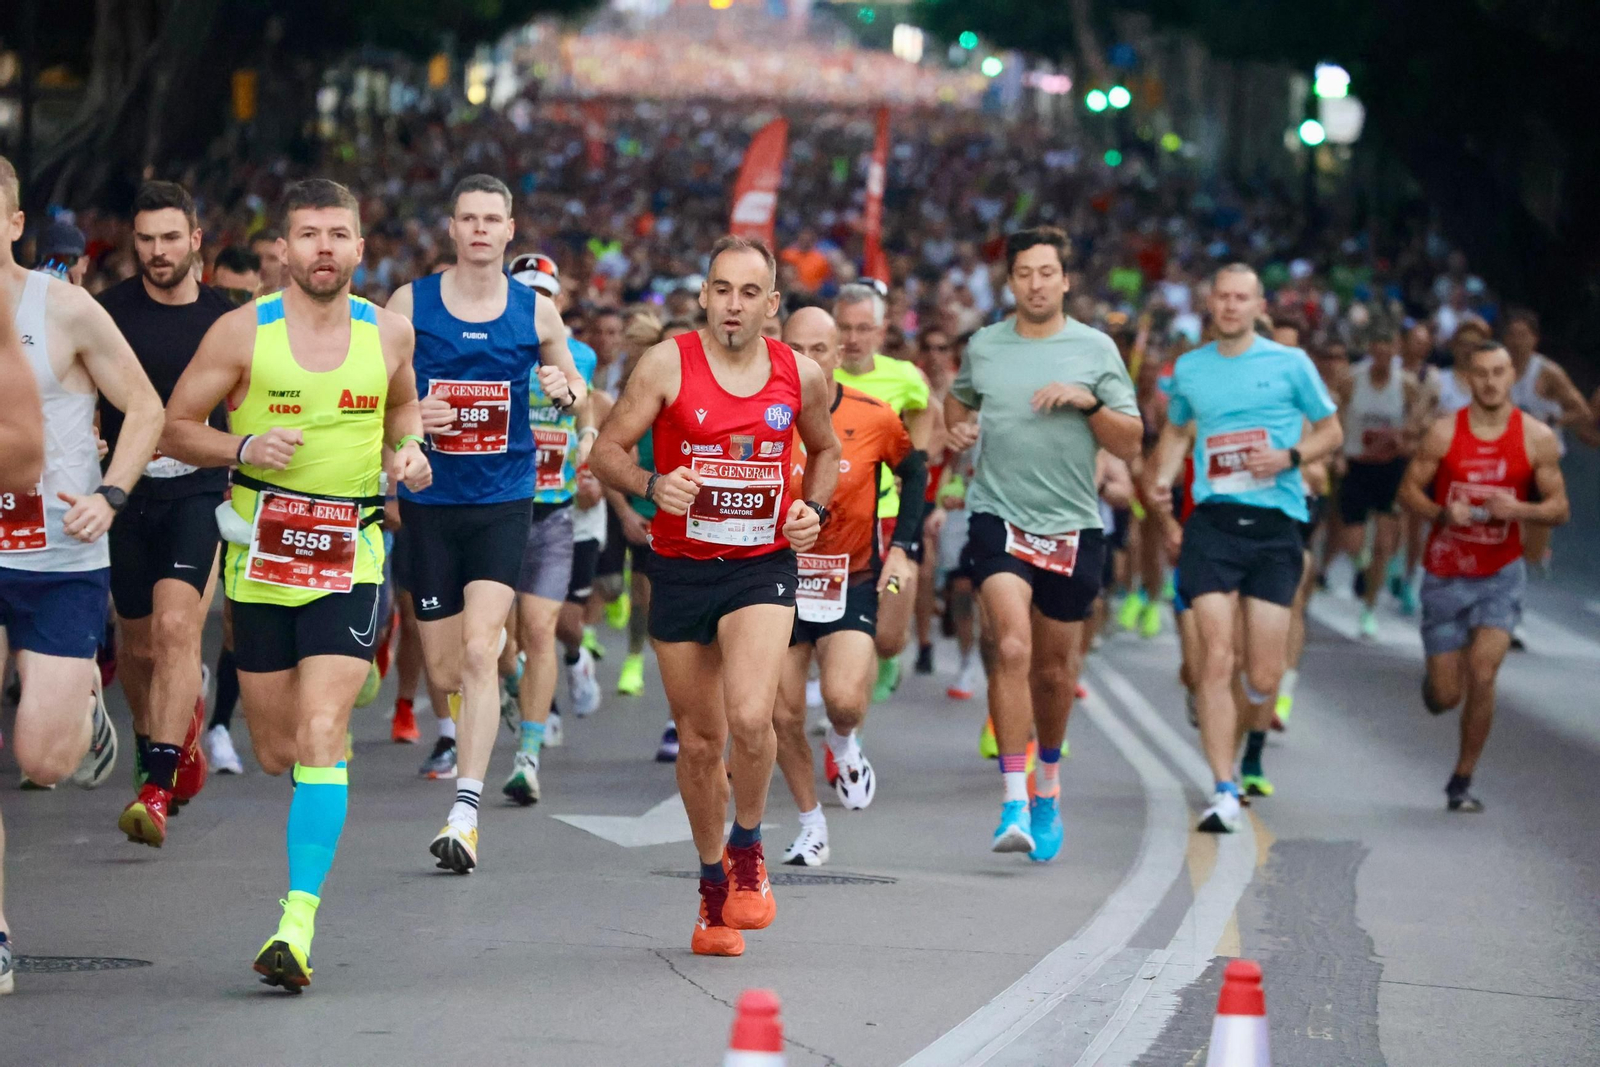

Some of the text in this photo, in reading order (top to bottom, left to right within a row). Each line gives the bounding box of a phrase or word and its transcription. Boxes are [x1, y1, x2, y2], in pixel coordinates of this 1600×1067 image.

[462, 332, 488, 340] FUSION
[267, 390, 301, 398] TRIMTEX
[451, 384, 504, 397] GENERALI
[338, 389, 379, 409] Anu
[719, 465, 775, 479] GENERALI
[711, 490, 763, 509] 13339
[288, 501, 352, 521] GENERALI
[719, 508, 753, 516] SALVATORE
[281, 528, 331, 551] 5558
[295, 548, 314, 556] EERO
[797, 558, 842, 568] ENERALI
